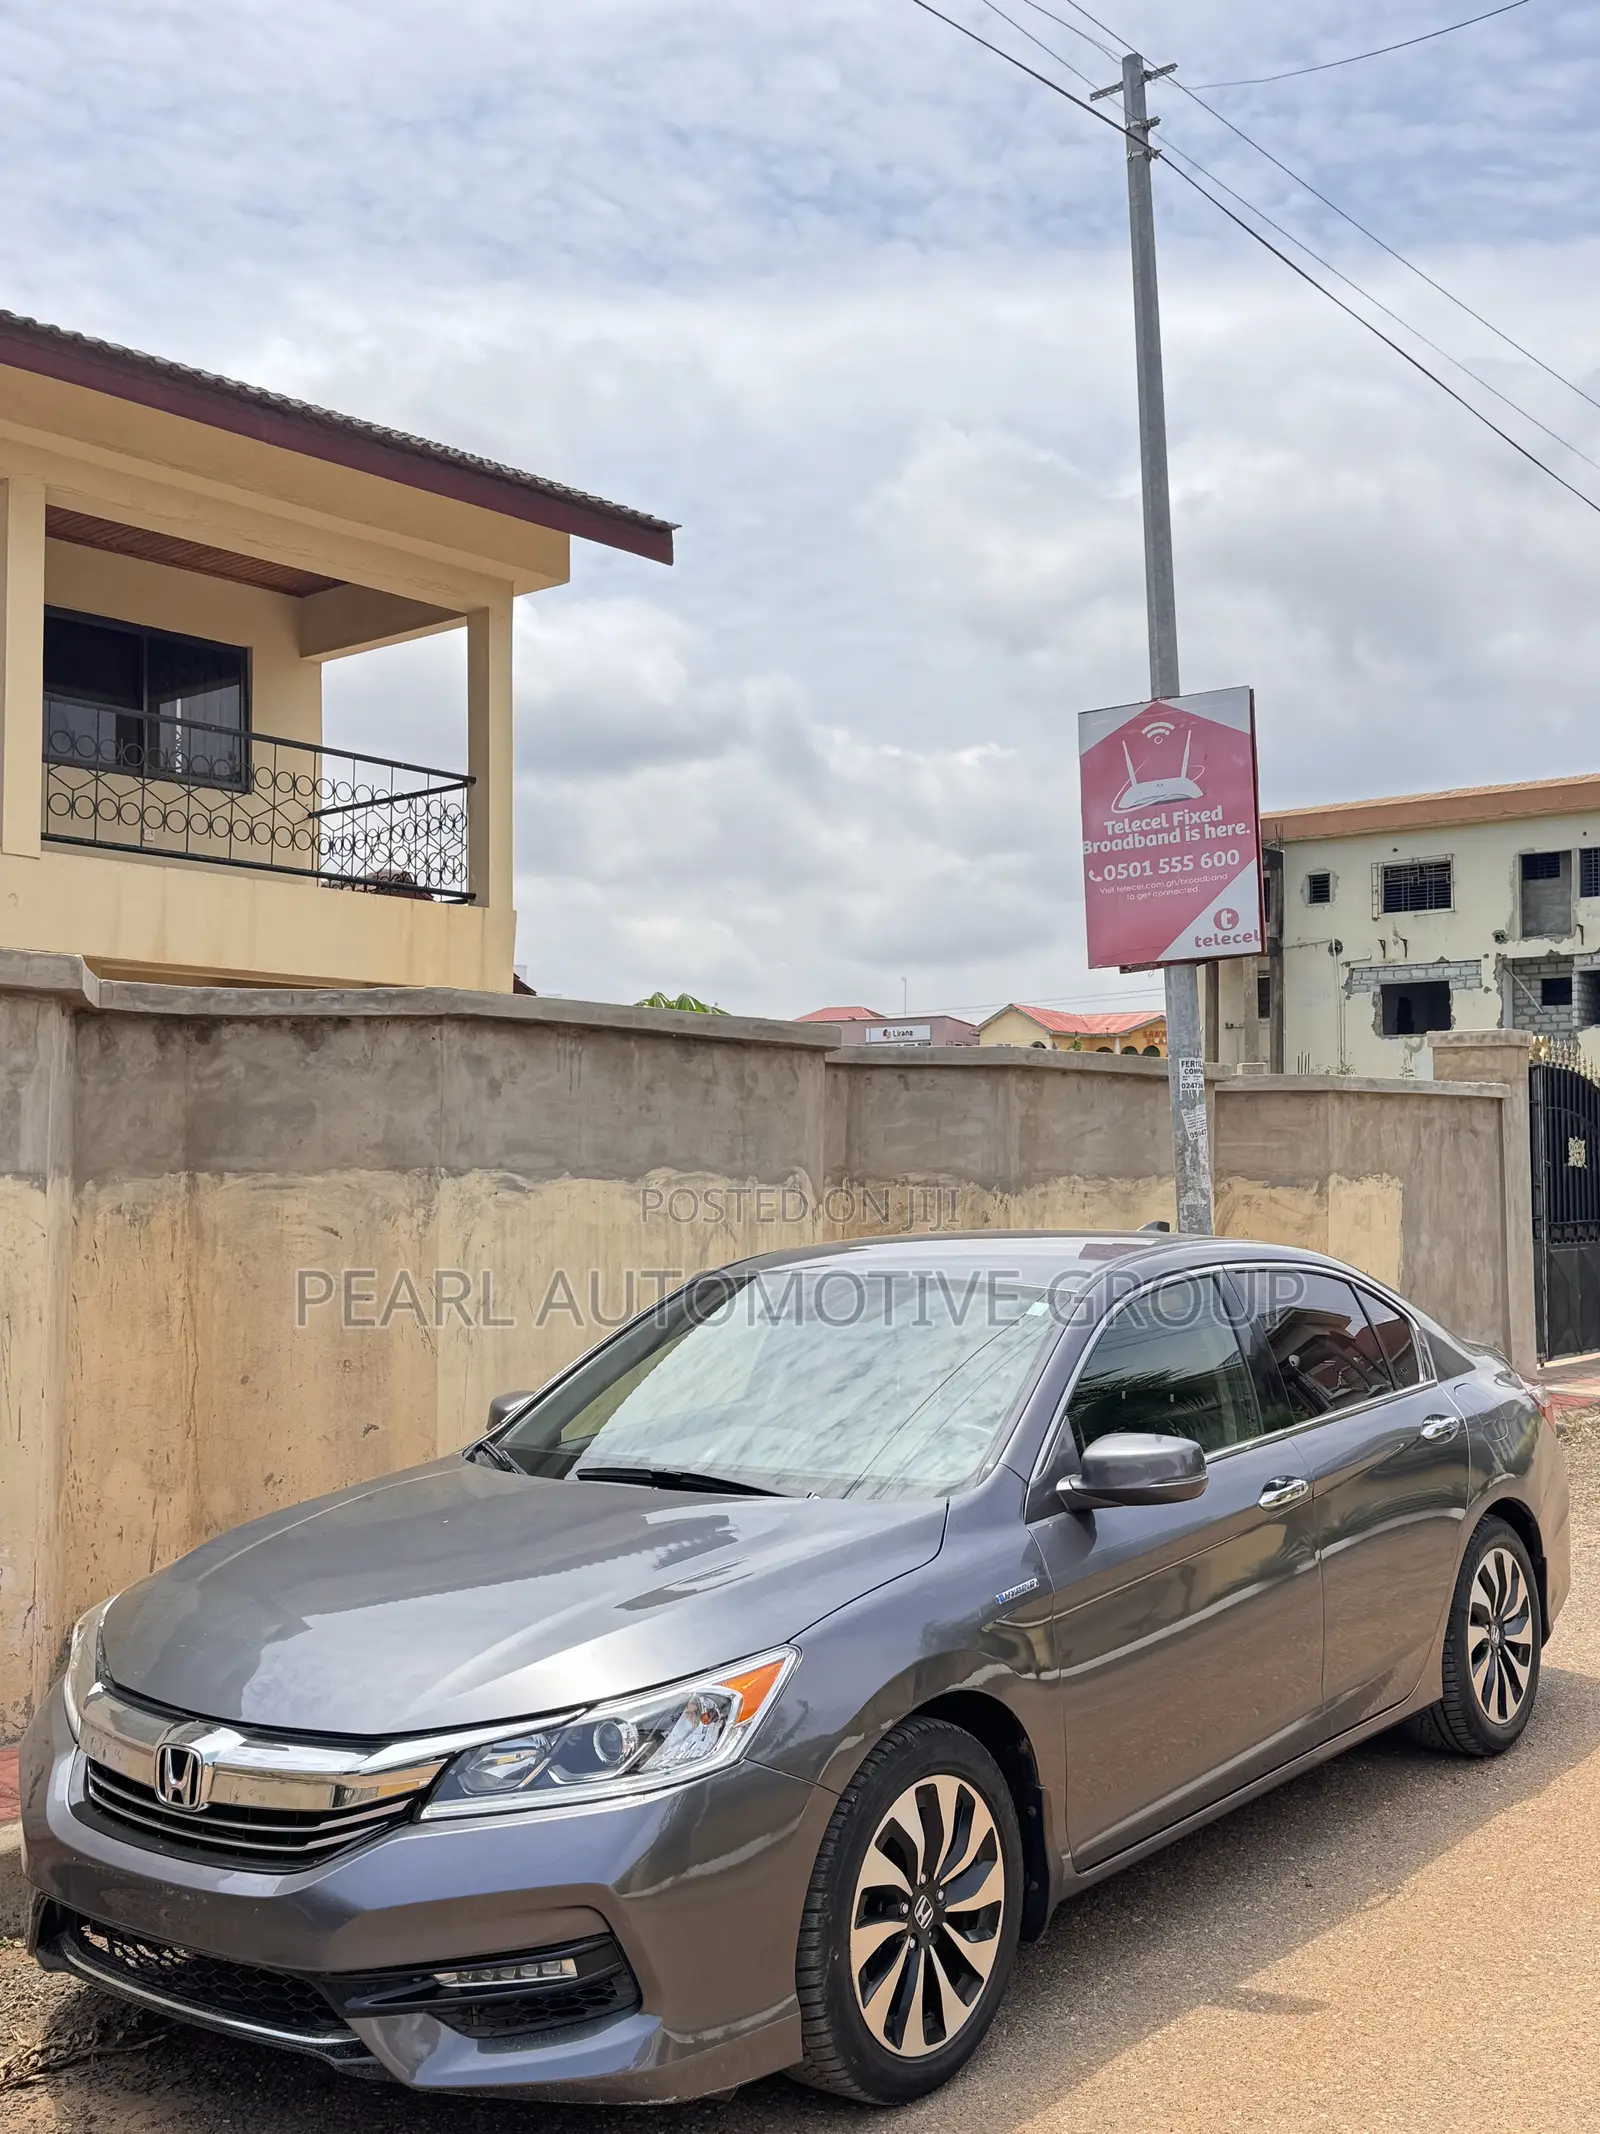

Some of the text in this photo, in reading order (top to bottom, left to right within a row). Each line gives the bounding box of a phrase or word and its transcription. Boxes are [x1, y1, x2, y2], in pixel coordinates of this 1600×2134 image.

[1104, 805, 1223, 836] Telecel Fixed
[1083, 822, 1251, 855] Broadband is here.
[1103, 849, 1240, 881] 0501 555 600
[1194, 928, 1261, 948] telecel
